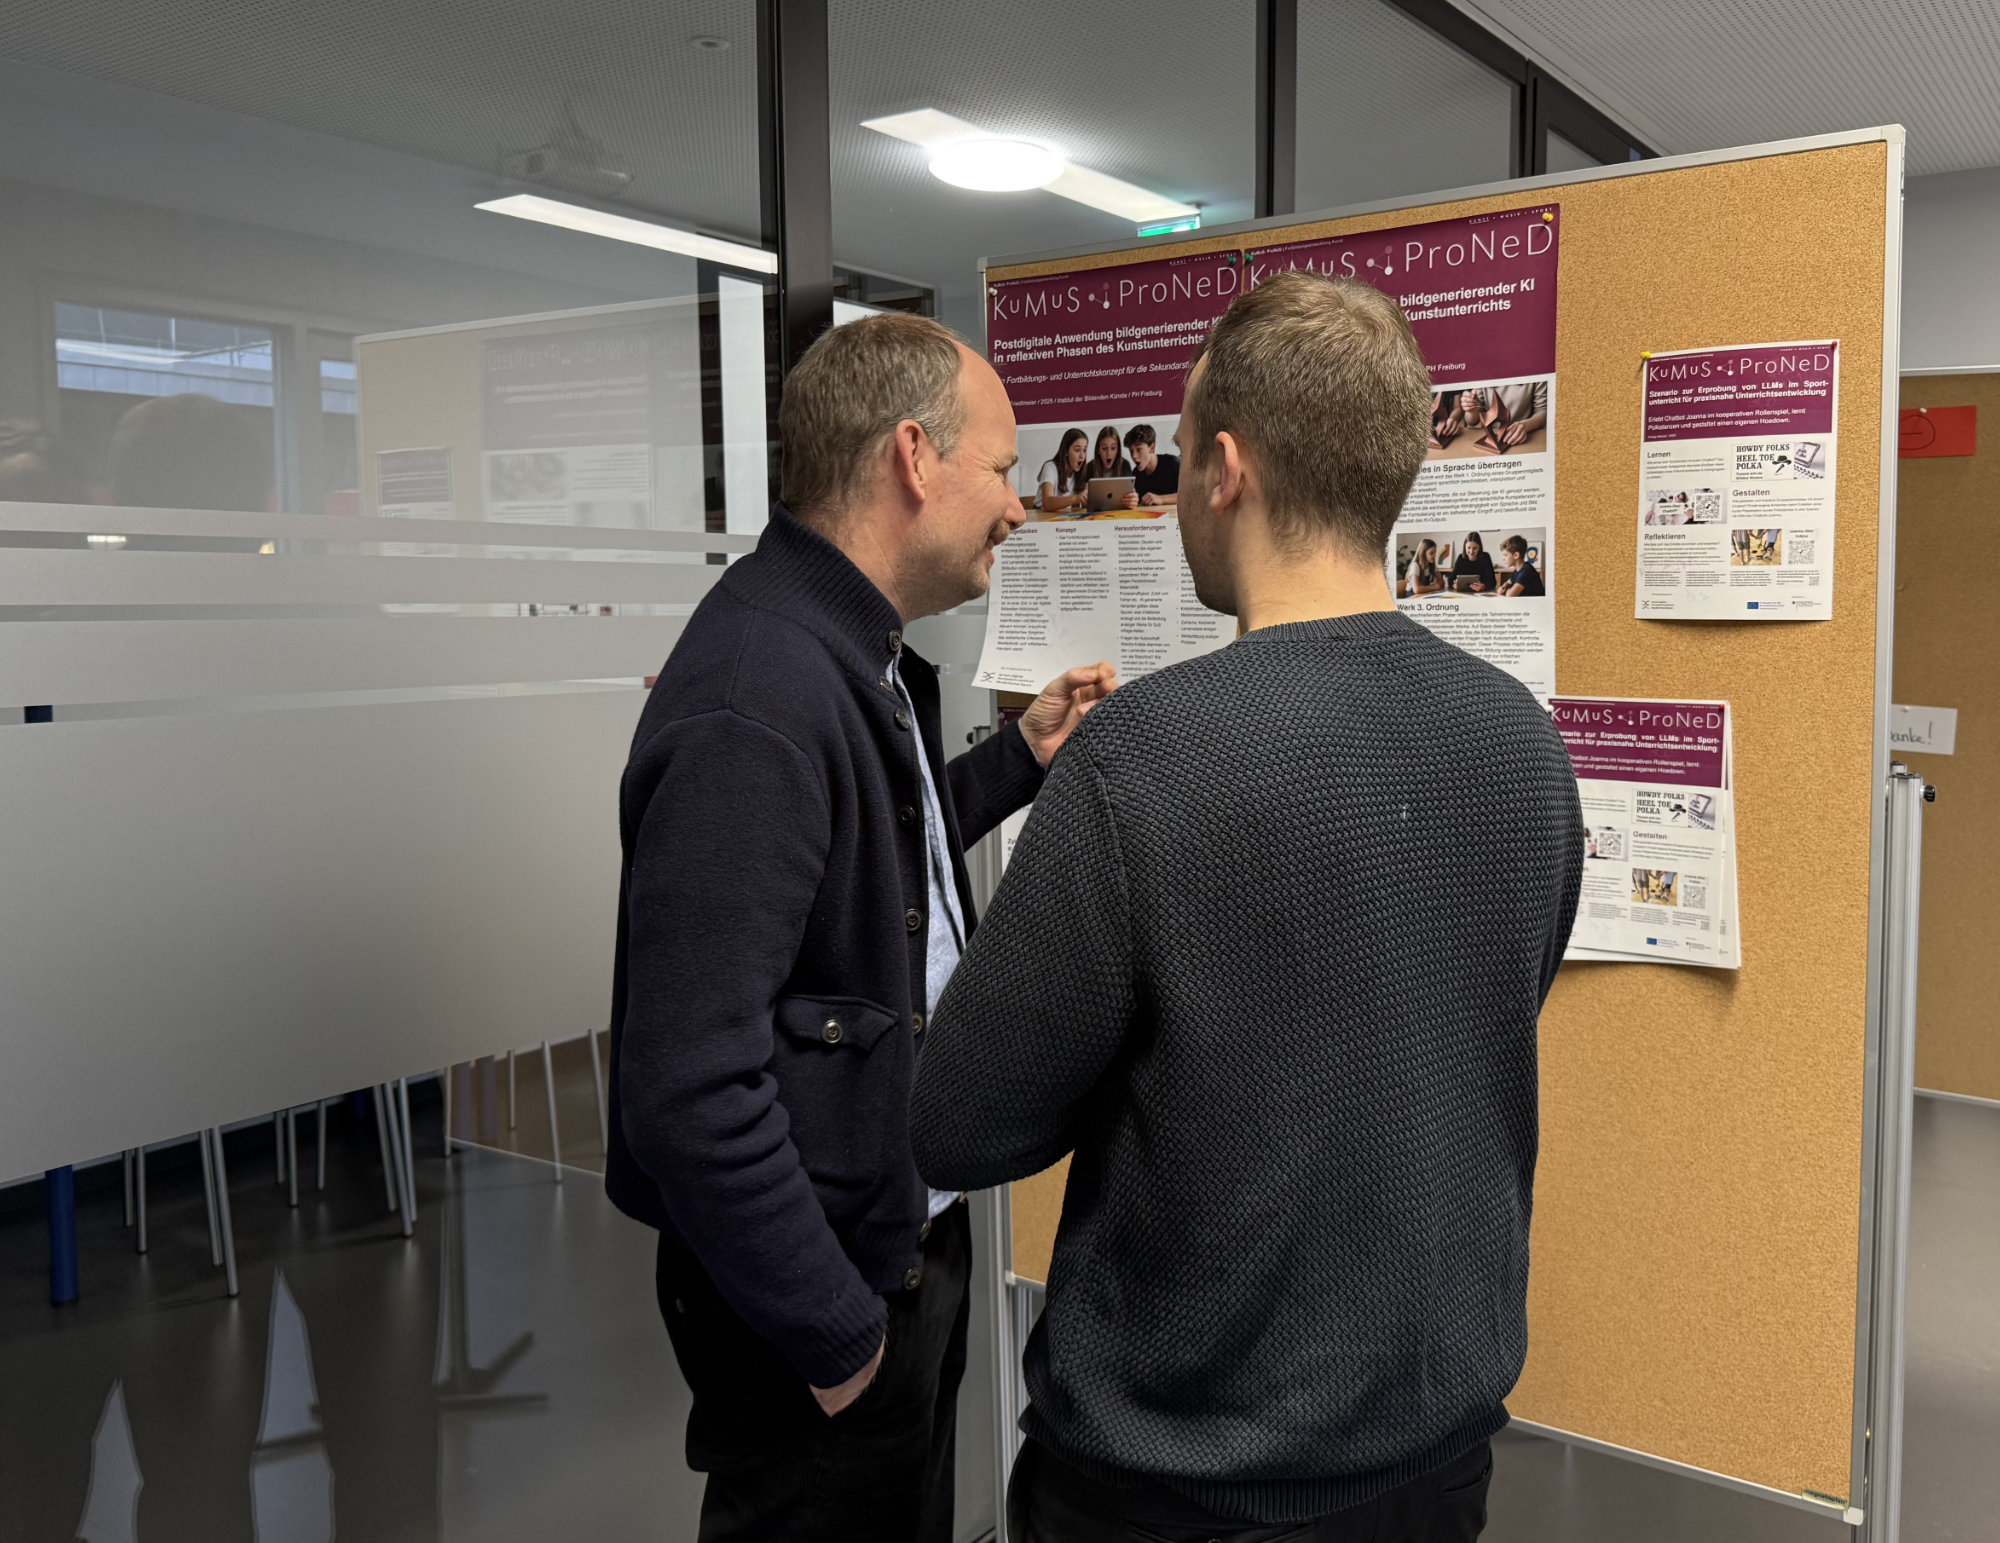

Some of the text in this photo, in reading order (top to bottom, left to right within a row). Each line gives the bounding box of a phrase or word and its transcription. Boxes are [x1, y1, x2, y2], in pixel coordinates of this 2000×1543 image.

[1250, 223, 1553, 291] KuS ProNeD
[994, 267, 1237, 320] KuMuS ProNeD
[1400, 278, 1535, 307] bildgenerierender KI
[994, 335, 1052, 350] Postdigitale
[1054, 330, 1113, 345] Anwendung
[1116, 319, 1209, 338] bildgenerierender
[994, 334, 1204, 363] in reflexiven Phasen des Kunstunterrichts
[1050, 372, 1062, 381] und
[1126, 366, 1135, 375] für
[1137, 364, 1147, 373] die
[1438, 362, 1466, 371] Freiburg
[1649, 353, 1829, 383] KuMuS ProNeD
[1649, 389, 1678, 398] Szenario
[1698, 385, 1736, 394] Erprobung
[1804, 380, 1829, 388] Sport-
[1649, 396, 1681, 405] unterricht
[1693, 393, 1734, 403] praxisnahe
[1735, 389, 1826, 399] Unterrichtsentwicklung
[1736, 443, 1790, 453] HOWDY FOLKS
[1736, 453, 1775, 462] HEEL TOE
[1443, 463, 1475, 473] Sprache
[1478, 460, 1522, 470] übertragen
[1736, 462, 1762, 470] POLKA
[1732, 489, 1770, 497] Gestalten
[1397, 603, 1415, 611] Werk
[1426, 603, 1459, 612] Ordnung
[1551, 707, 1721, 729] KuMuS ProNeD
[1600, 731, 1637, 741] Erprobung
[1683, 735, 1693, 743] im
[1635, 741, 1717, 753] Unterrichtsentwicklung
